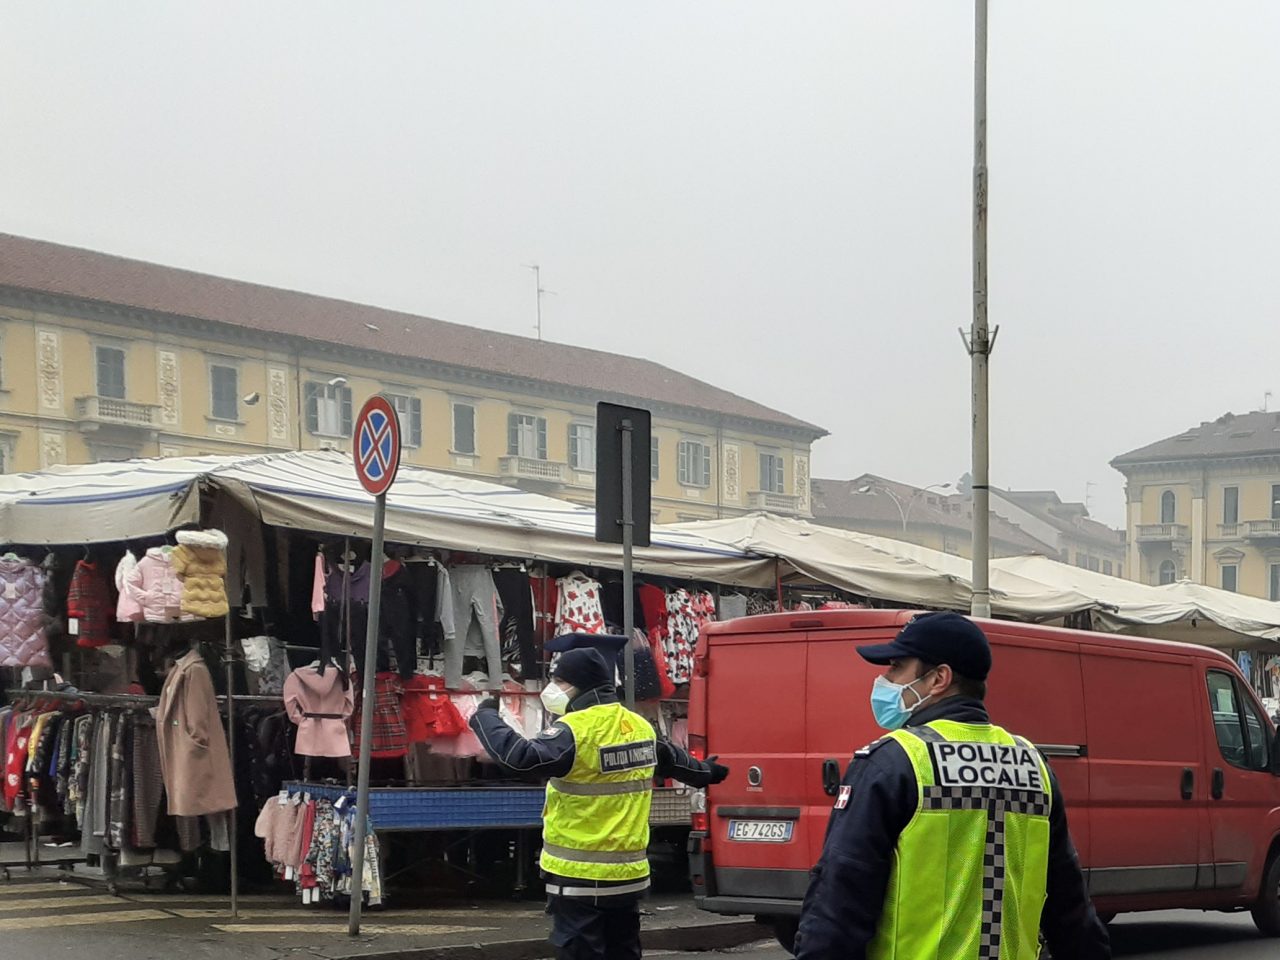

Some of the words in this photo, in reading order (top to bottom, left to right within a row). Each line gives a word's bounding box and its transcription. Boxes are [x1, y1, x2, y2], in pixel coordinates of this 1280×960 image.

[939, 744, 1036, 767] POLIZIA
[942, 765, 1041, 788] LOCALE
[735, 822, 750, 837] EG
[751, 823, 785, 838] 742GS
